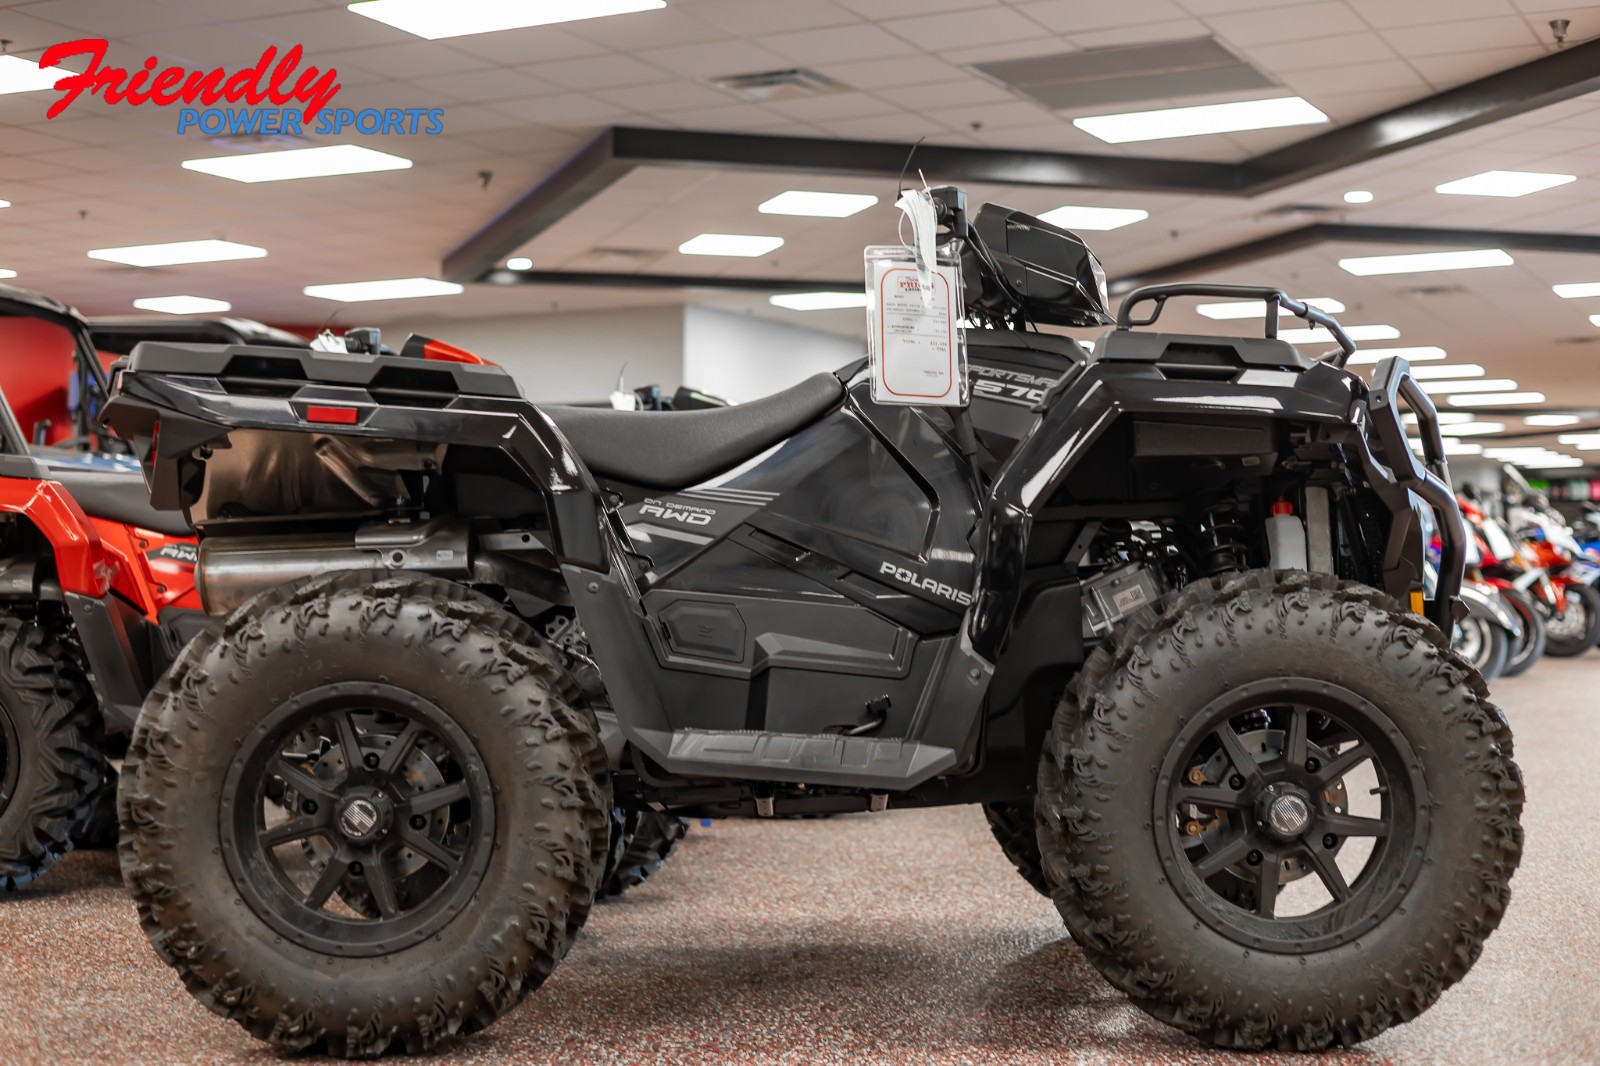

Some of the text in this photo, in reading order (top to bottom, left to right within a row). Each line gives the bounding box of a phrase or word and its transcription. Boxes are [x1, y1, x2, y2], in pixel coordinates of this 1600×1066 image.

[639, 504, 712, 526] AWD
[644, 498, 716, 515] ON DEMAND
[880, 561, 972, 606] POLARIS
